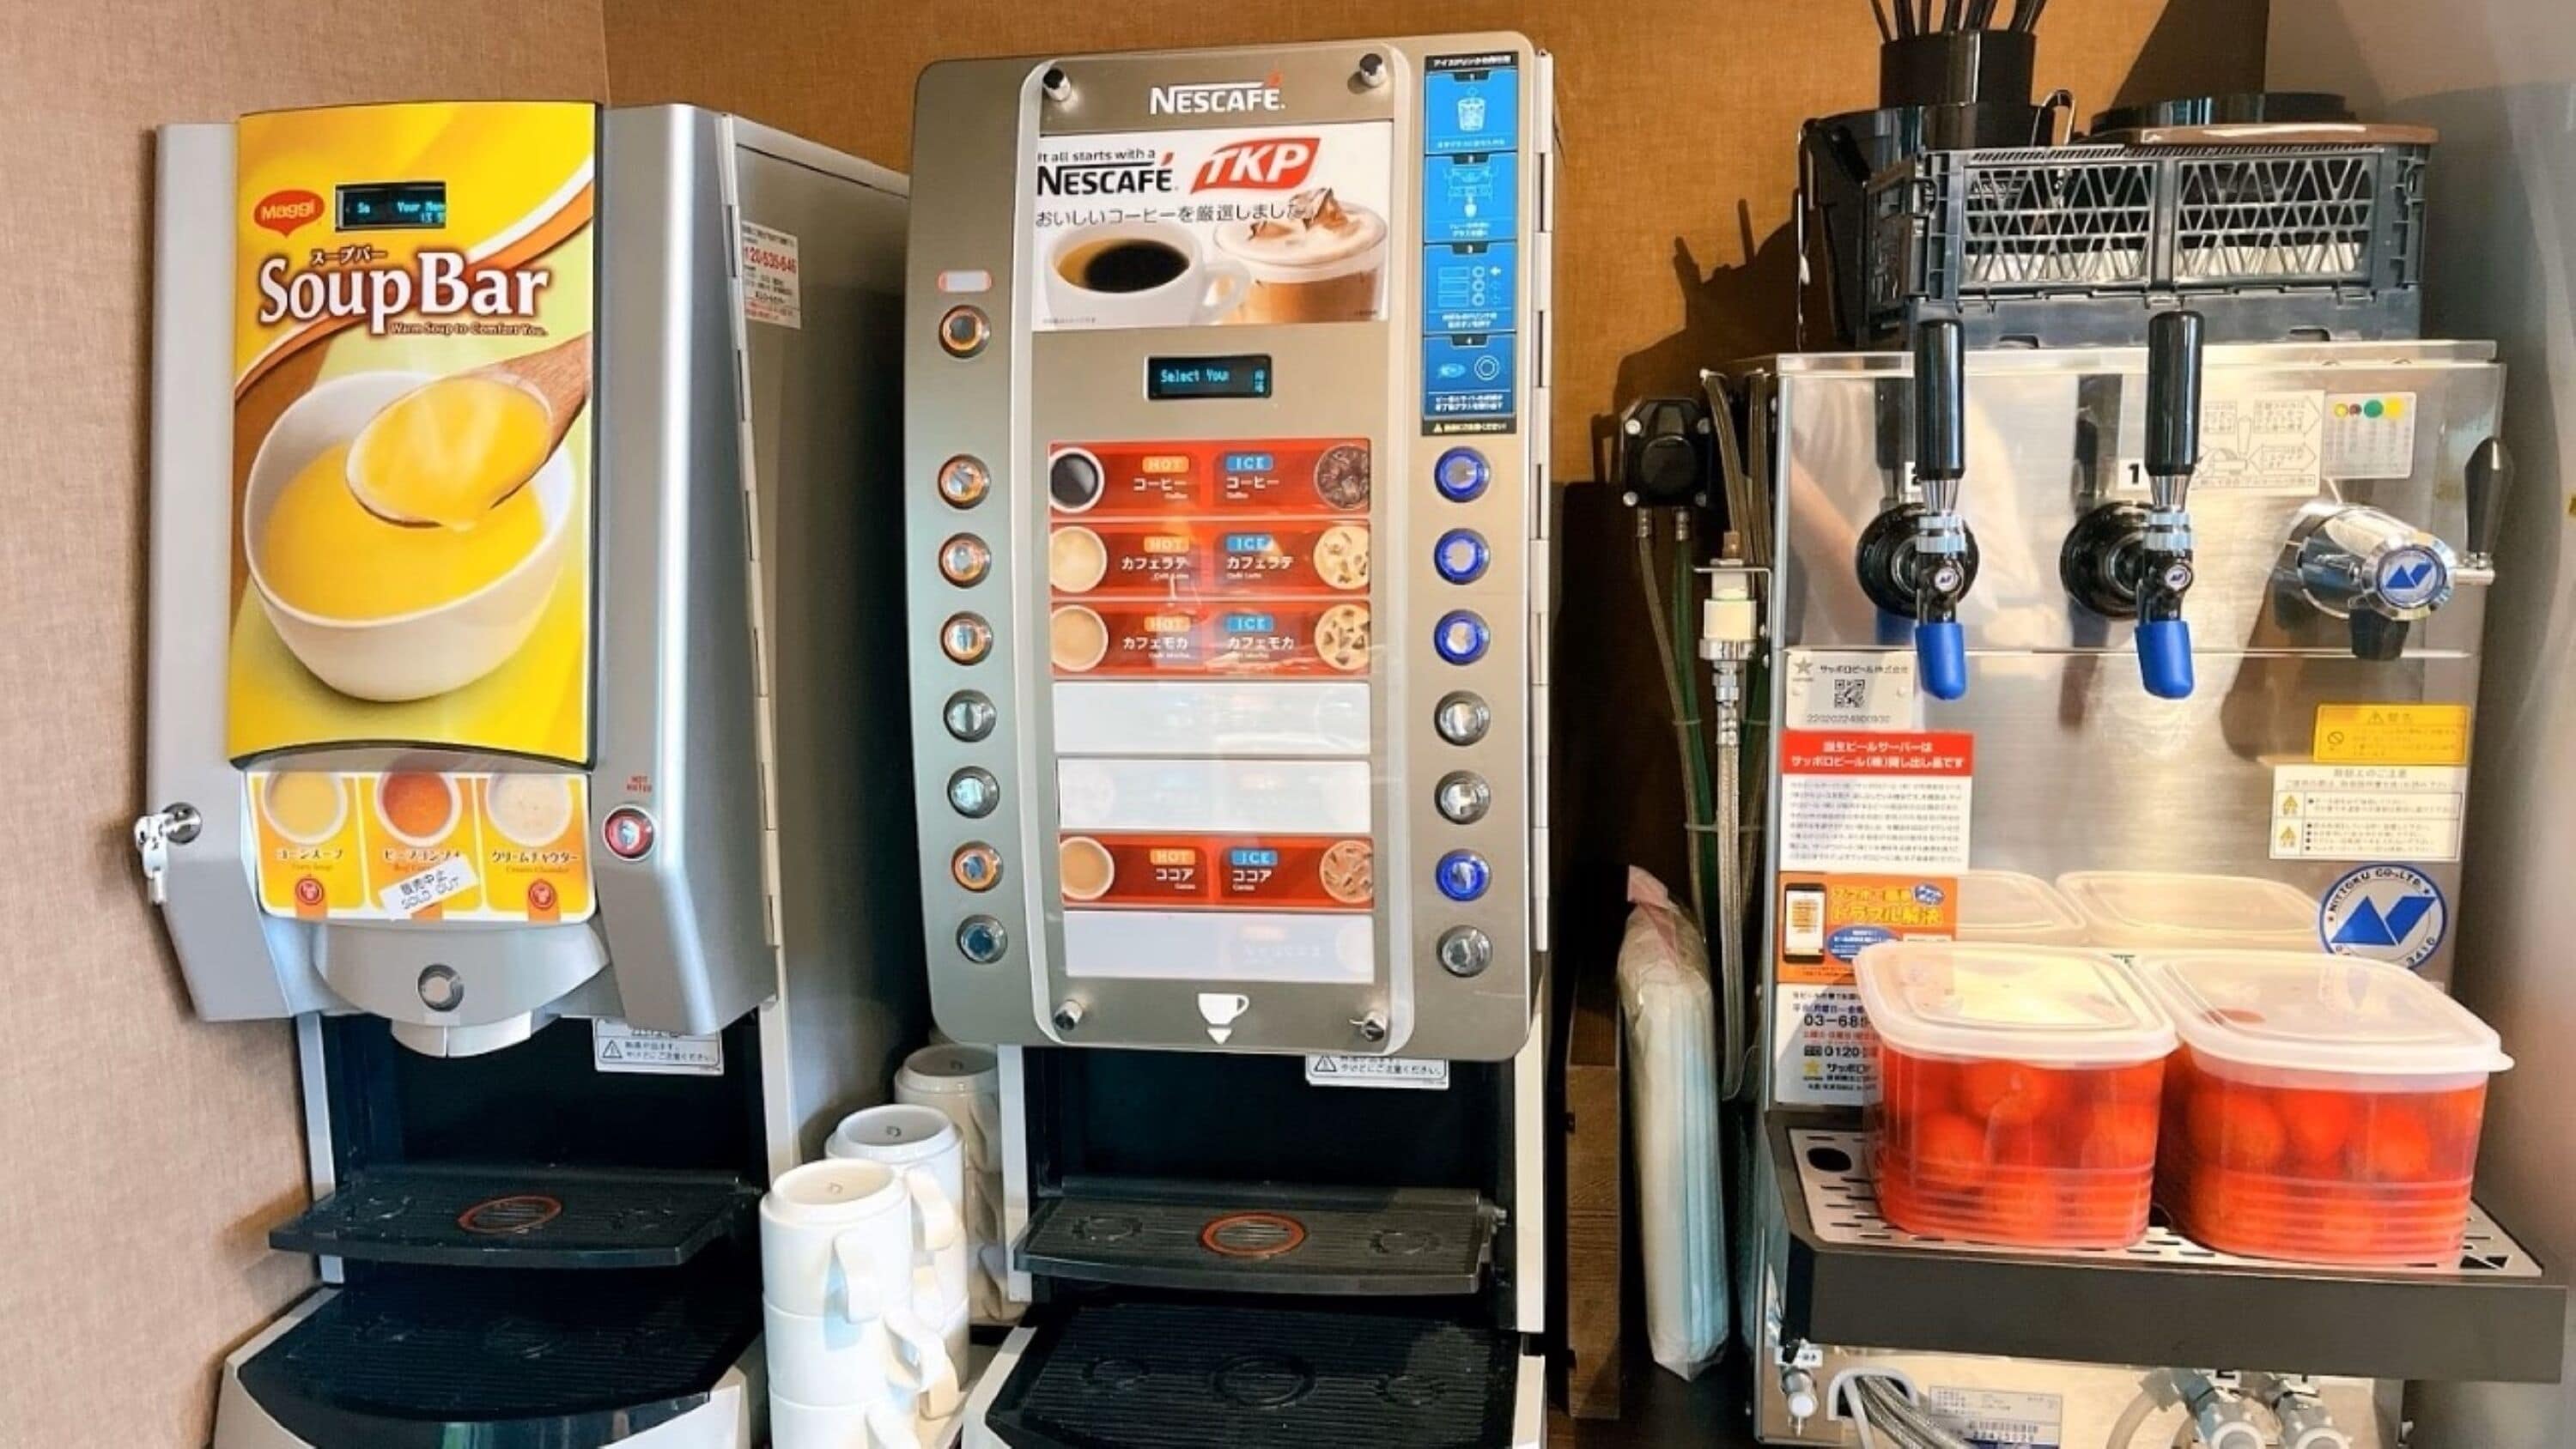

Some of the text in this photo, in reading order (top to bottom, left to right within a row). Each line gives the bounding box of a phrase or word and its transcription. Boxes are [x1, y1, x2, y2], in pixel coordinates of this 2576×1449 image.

[1037, 149, 1156, 163] It all starts with a
[1208, 144, 1310, 183] TKP
[261, 200, 315, 221] Maggi
[312, 246, 389, 265] スープバー
[260, 252, 550, 335] Soup Bar
[392, 322, 423, 334] Warm
[424, 322, 453, 336] Soup
[454, 323, 468, 335] to
[471, 322, 519, 335] Comfort
[1160, 368, 1200, 383] Select
[1236, 457, 1265, 470] ICE
[2129, 464, 2140, 484] 1
[1133, 476, 1279, 491] コーヒー コーヒー
[1236, 537, 1266, 549] ICE
[1121, 556, 1294, 570] カフェラテ カフェラテ
[1237, 618, 1266, 630] ICE
[1123, 637, 1294, 651] カフェモカ カフェモカ
[1242, 851, 1271, 864] ICE
[1156, 868, 1273, 882] ココア ココア
[400, 876, 459, 910] SOLD OUT
